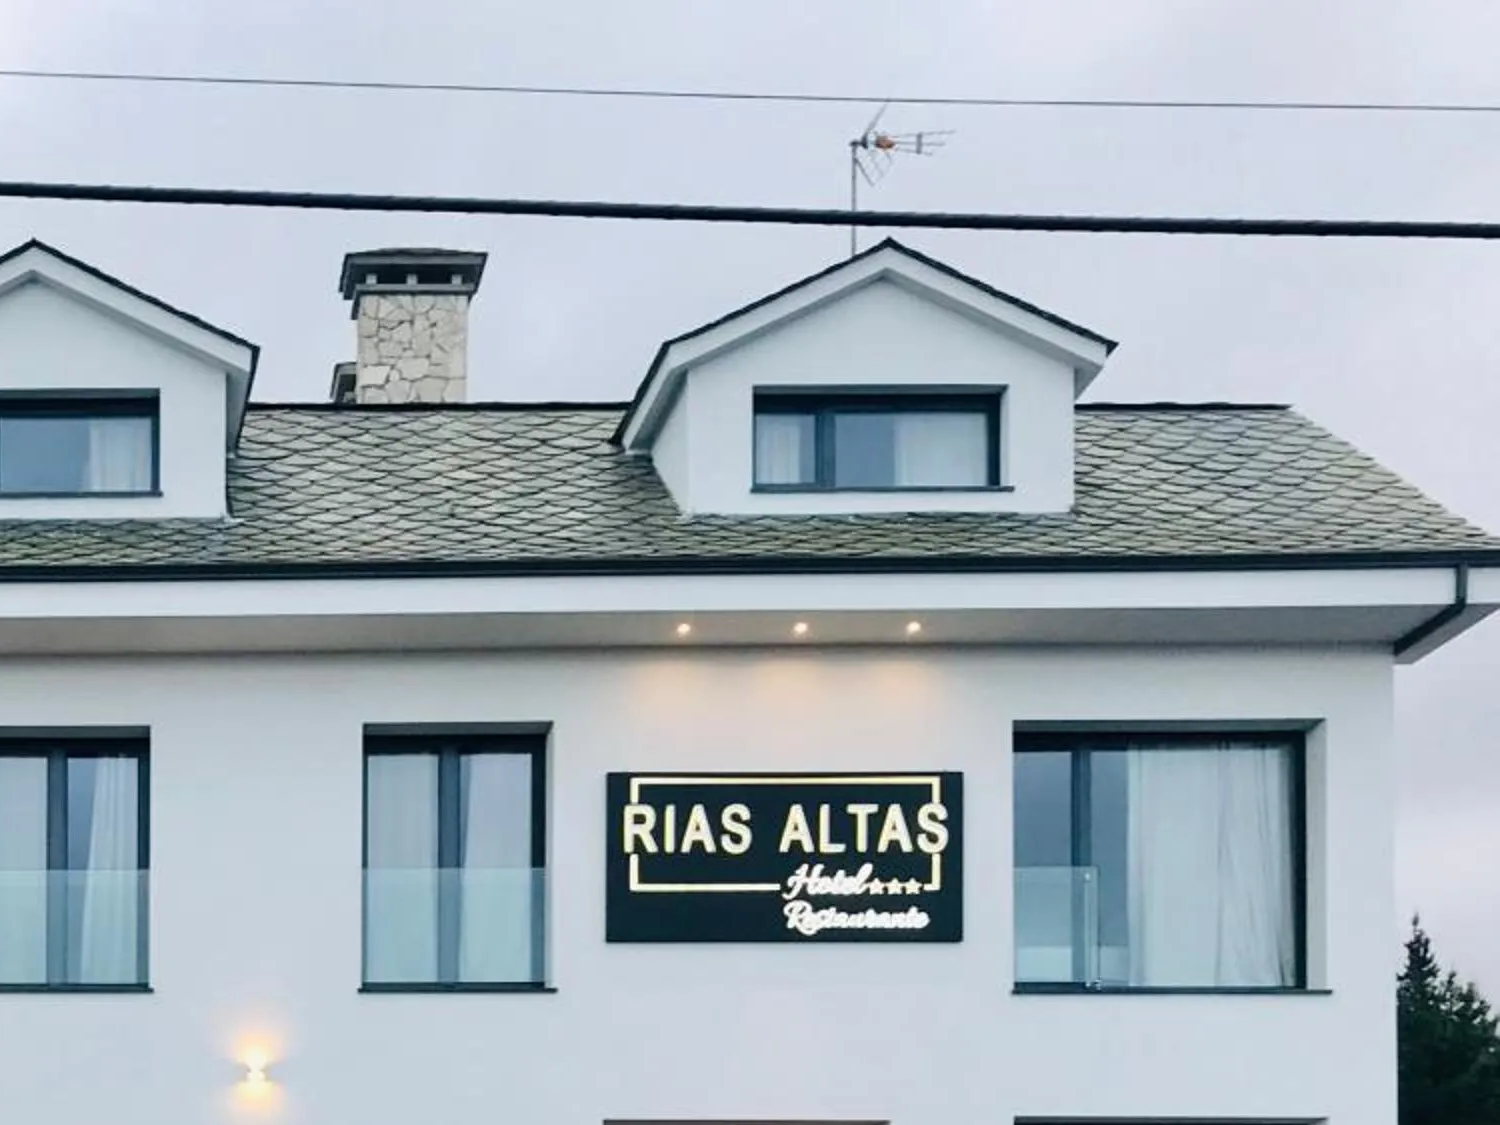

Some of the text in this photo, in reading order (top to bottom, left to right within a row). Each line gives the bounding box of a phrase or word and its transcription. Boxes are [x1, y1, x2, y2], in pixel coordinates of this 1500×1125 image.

[623, 803, 949, 854] RIAS ALTAS
[782, 862, 874, 900] Hotel
[783, 899, 931, 936] Restaurante
